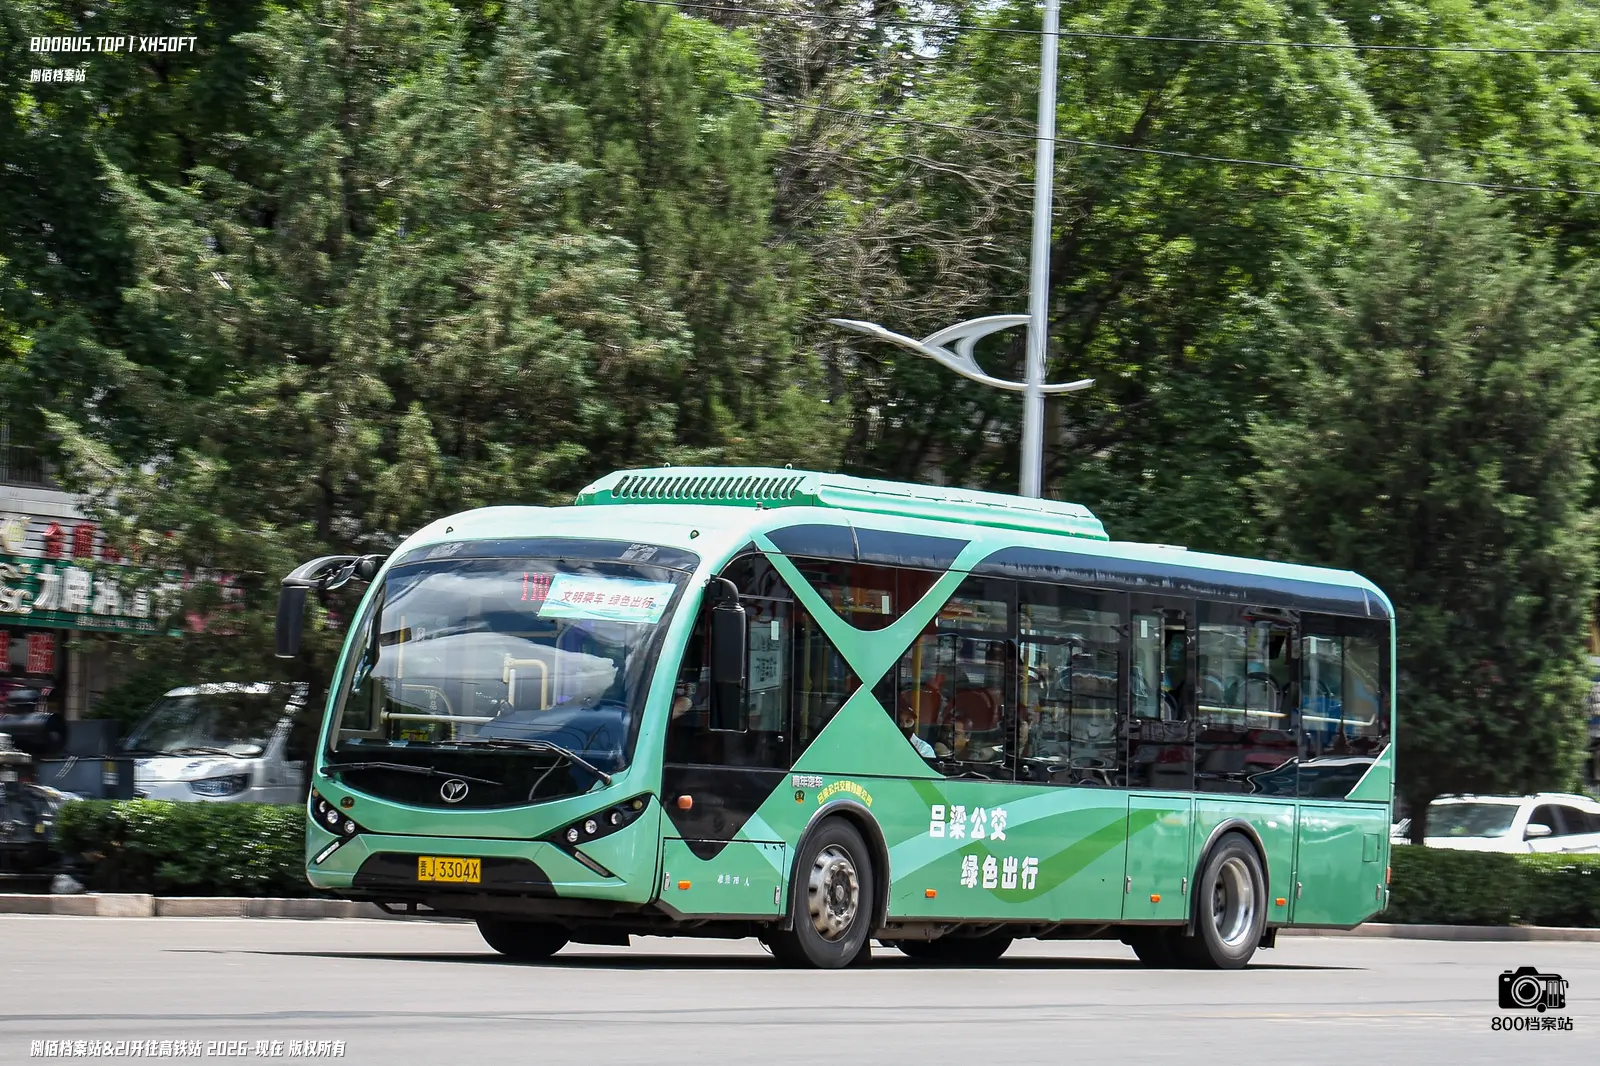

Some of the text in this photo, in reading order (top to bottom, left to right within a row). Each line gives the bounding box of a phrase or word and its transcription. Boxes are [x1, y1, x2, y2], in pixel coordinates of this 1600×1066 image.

[560, 590, 655, 609] 文明乘车 绿色出行
[929, 804, 1008, 841] 吕梁公交
[960, 854, 1039, 890] 绿色出行
